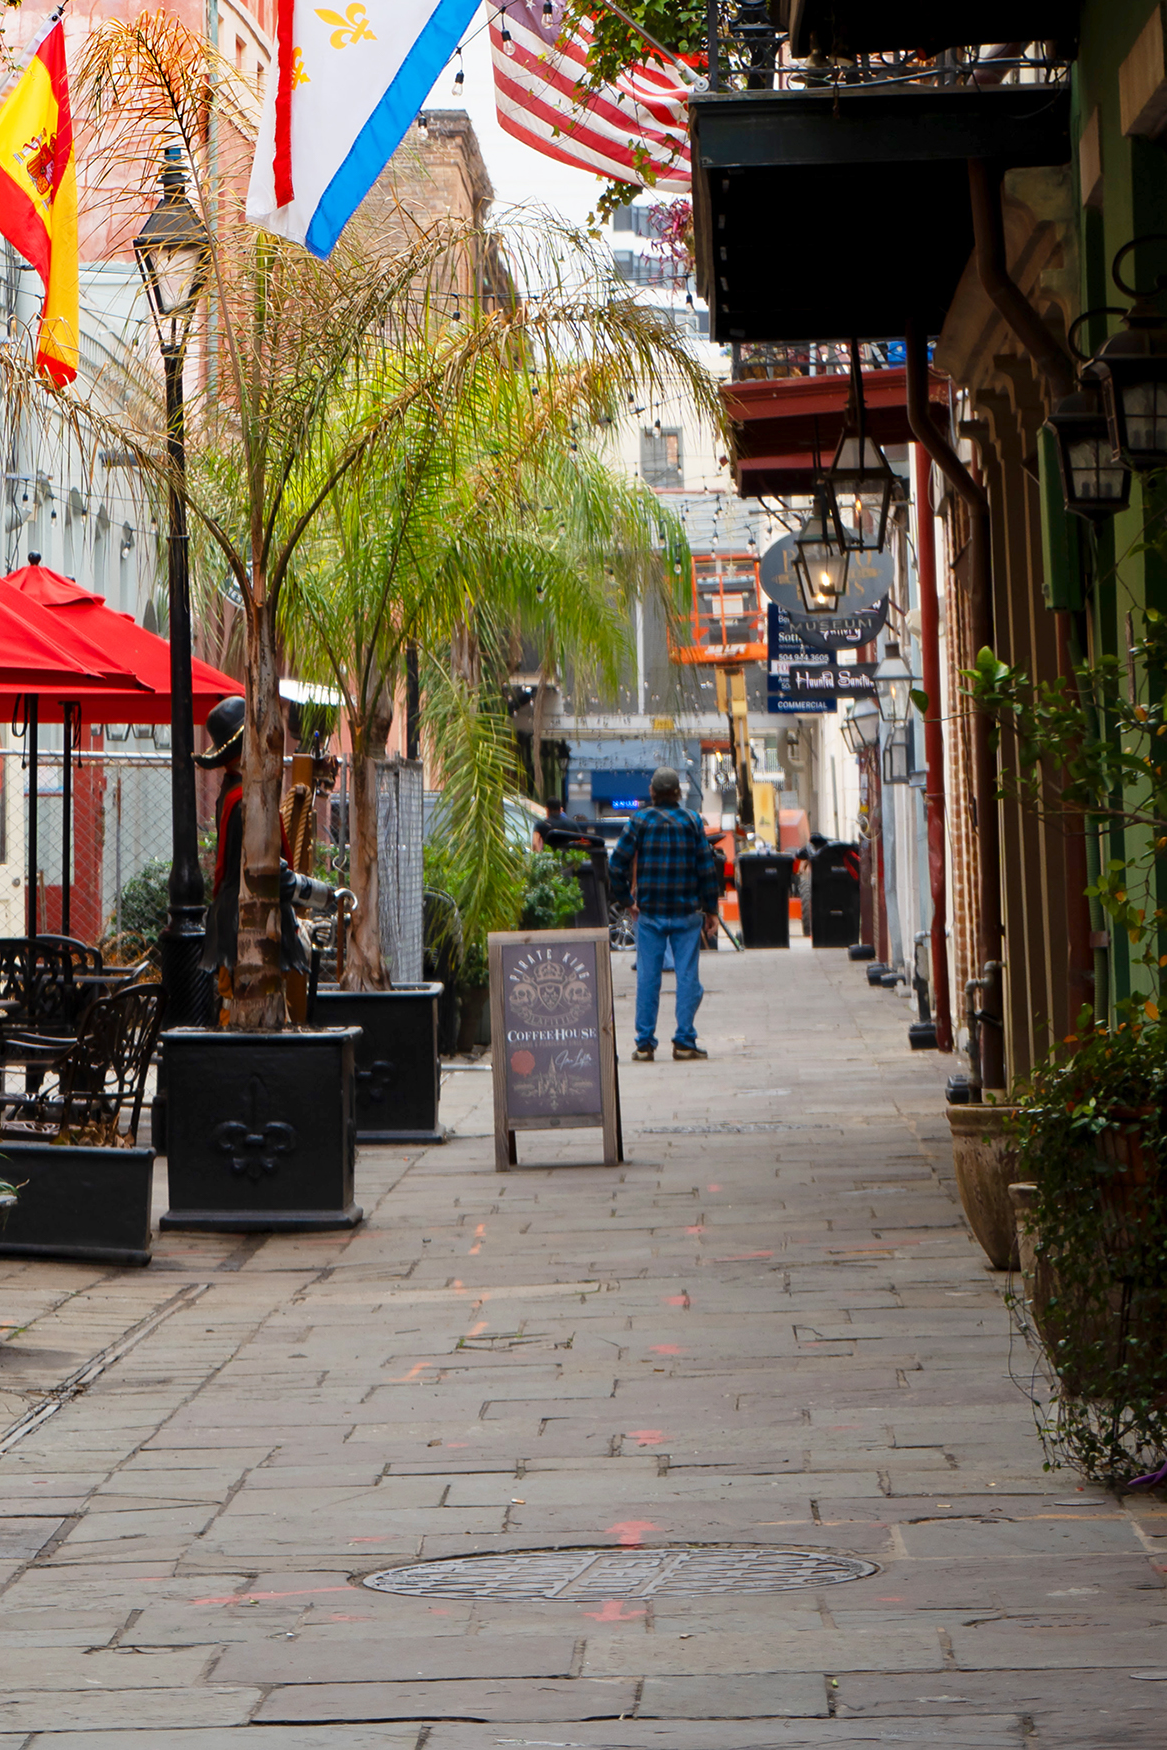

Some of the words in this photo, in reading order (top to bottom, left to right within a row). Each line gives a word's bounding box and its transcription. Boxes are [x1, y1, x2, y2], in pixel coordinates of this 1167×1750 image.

[789, 618, 872, 633] MUSEUM
[777, 700, 828, 710] COMMERCIAL
[509, 948, 553, 982] PIRATE
[562, 951, 590, 980] KING
